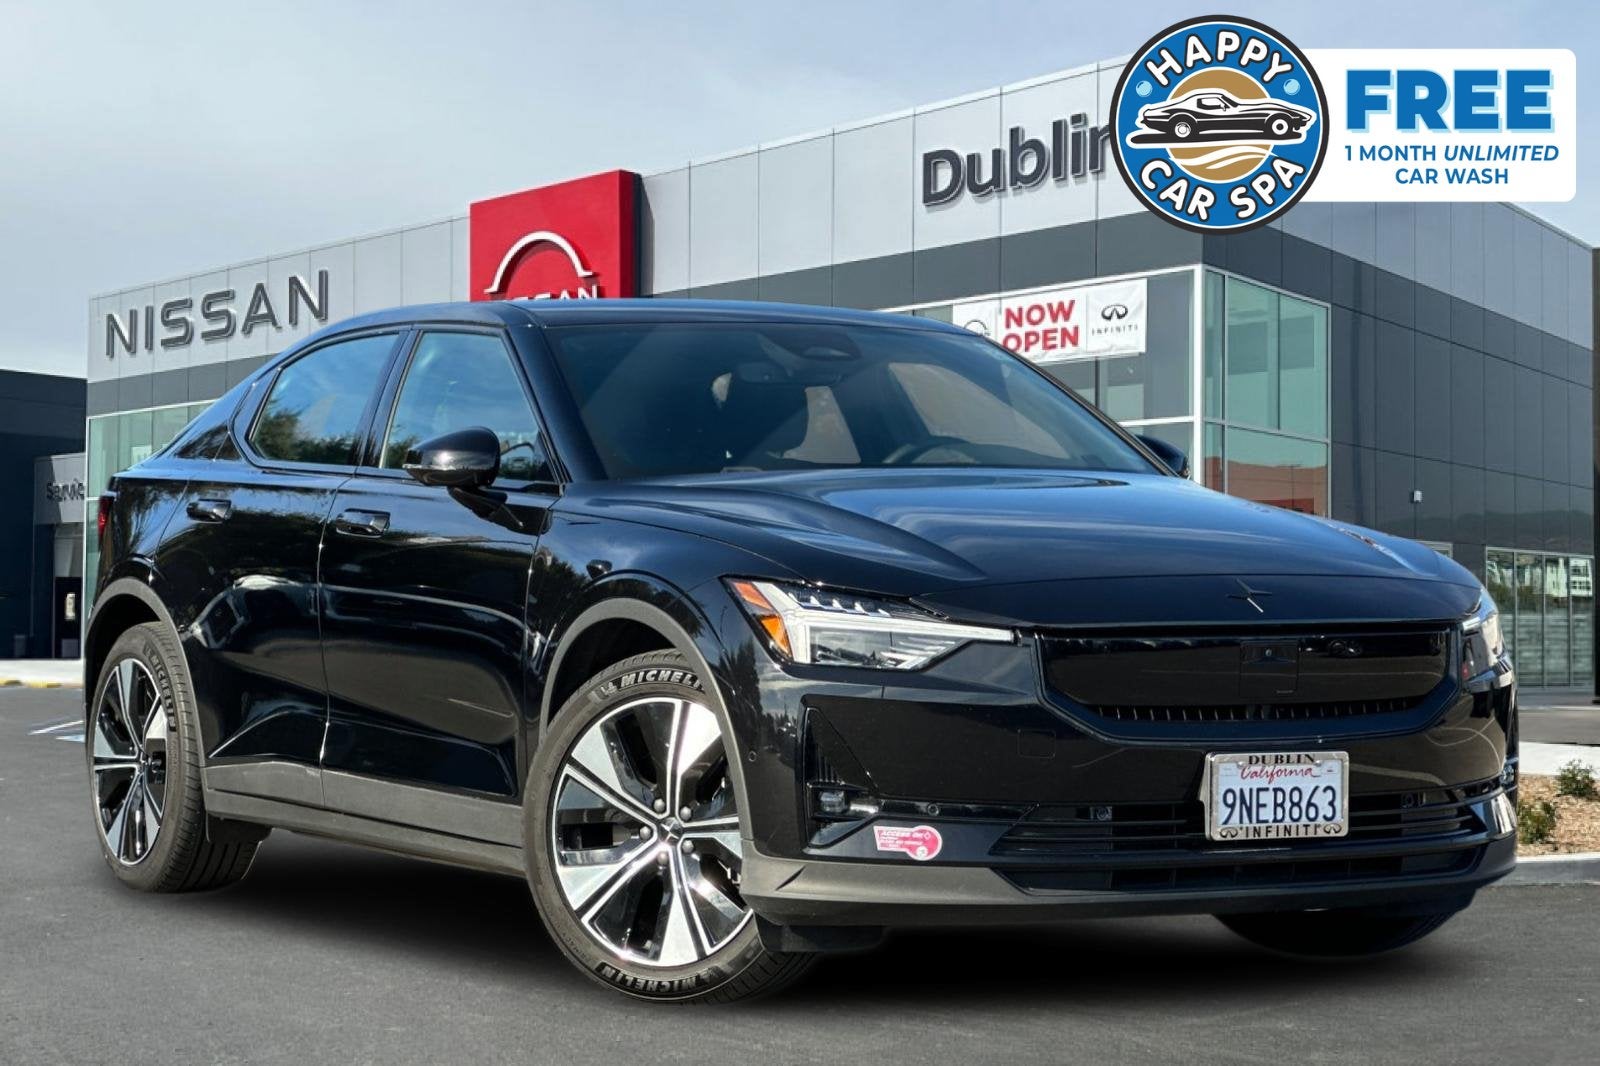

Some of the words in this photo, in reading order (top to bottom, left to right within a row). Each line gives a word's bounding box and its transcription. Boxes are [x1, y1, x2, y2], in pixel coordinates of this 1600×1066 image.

[106, 269, 329, 359] NISSAN
[1005, 299, 1076, 329] NOW
[1002, 325, 1079, 352] OPEN
[1091, 323, 1139, 337] INFINITI
[1248, 753, 1317, 765] DUBLIN
[1240, 765, 1321, 784] California
[1222, 786, 1337, 825] 9NEB863
[1245, 825, 1319, 838] INFINITI
[601, 965, 697, 993] MICHELIN
